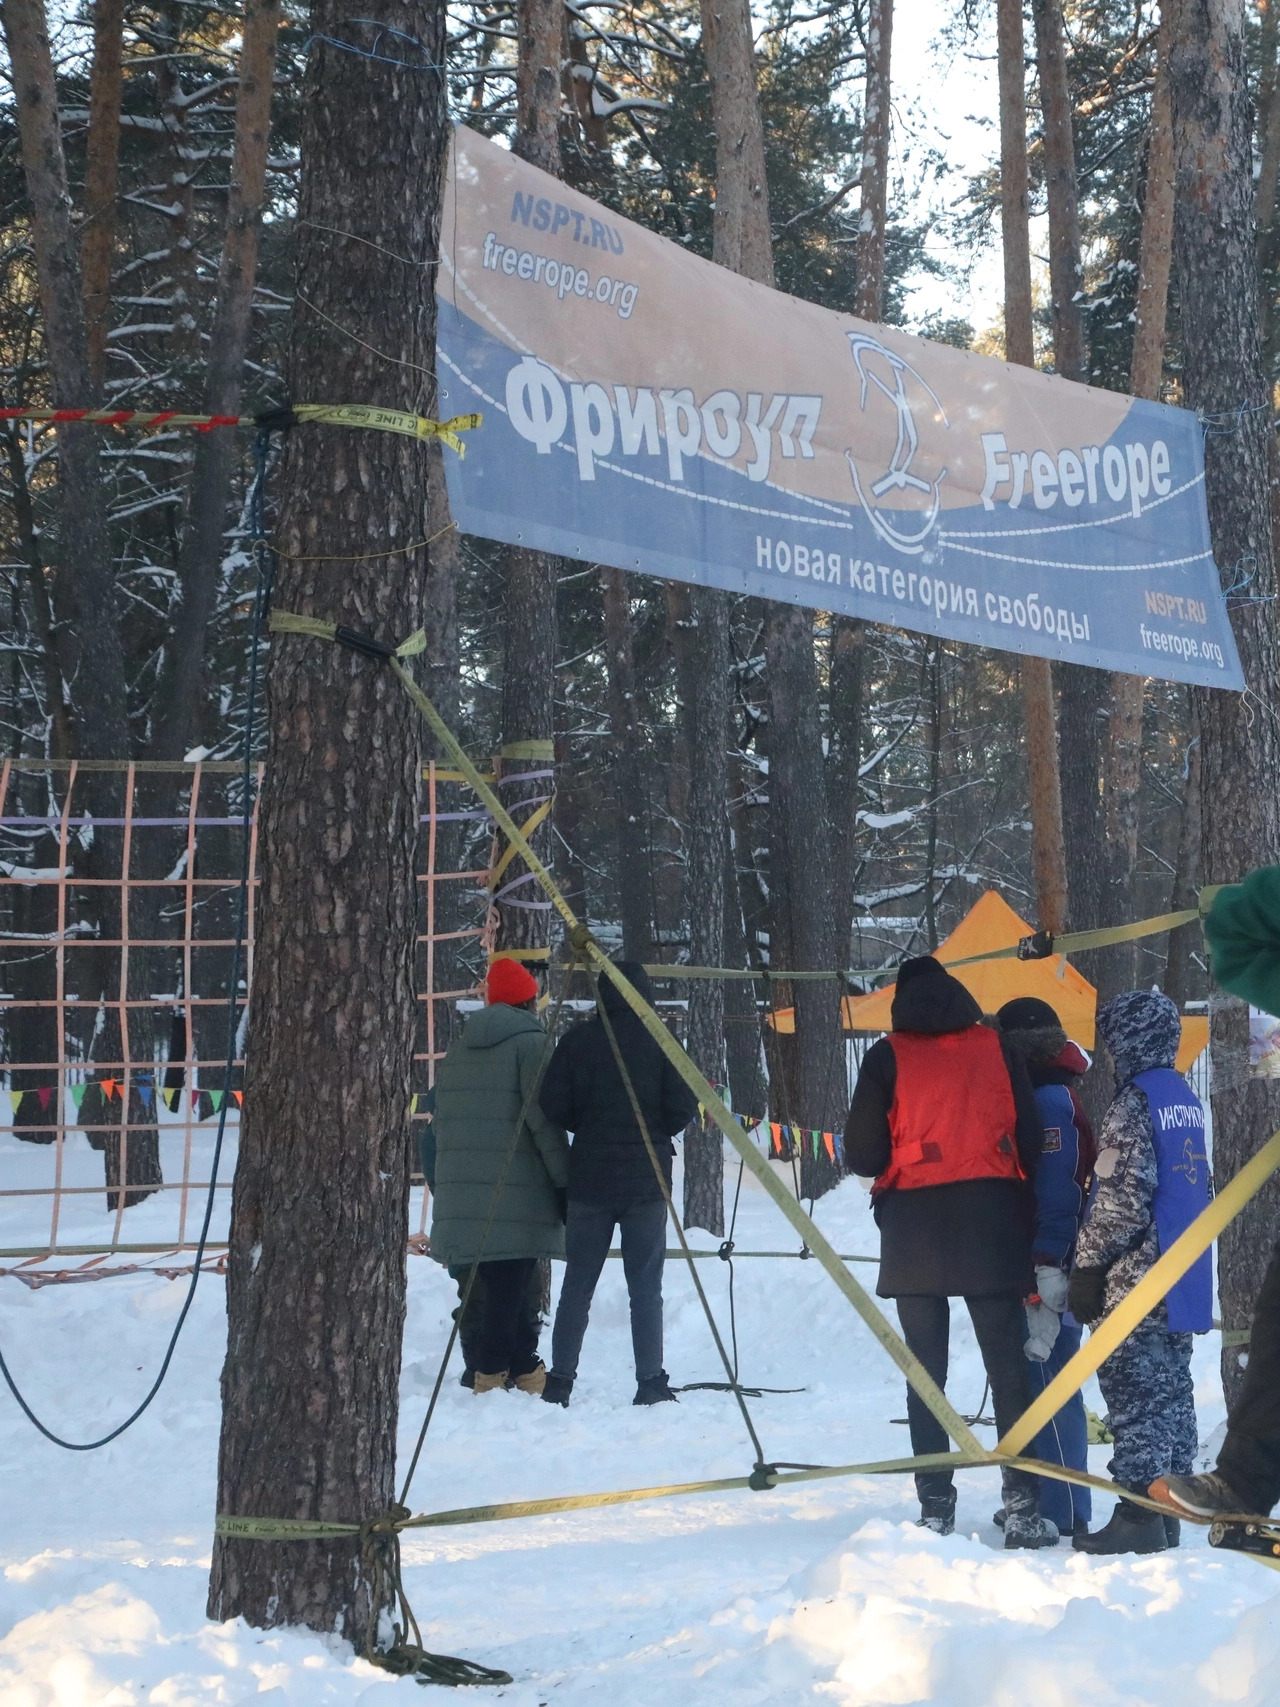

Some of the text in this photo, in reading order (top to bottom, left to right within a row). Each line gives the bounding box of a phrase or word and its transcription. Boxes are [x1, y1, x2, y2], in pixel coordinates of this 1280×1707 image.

[510, 191, 624, 255] NSPT.RU
[483, 232, 639, 320] freerope.org
[506, 355, 824, 482] Фрироуп
[980, 433, 1171, 518] Freerope
[756, 535, 1090, 644] новая категория свободы
[1144, 590, 1207, 625] NSPT.RU
[1140, 622, 1225, 668] freerope.org
